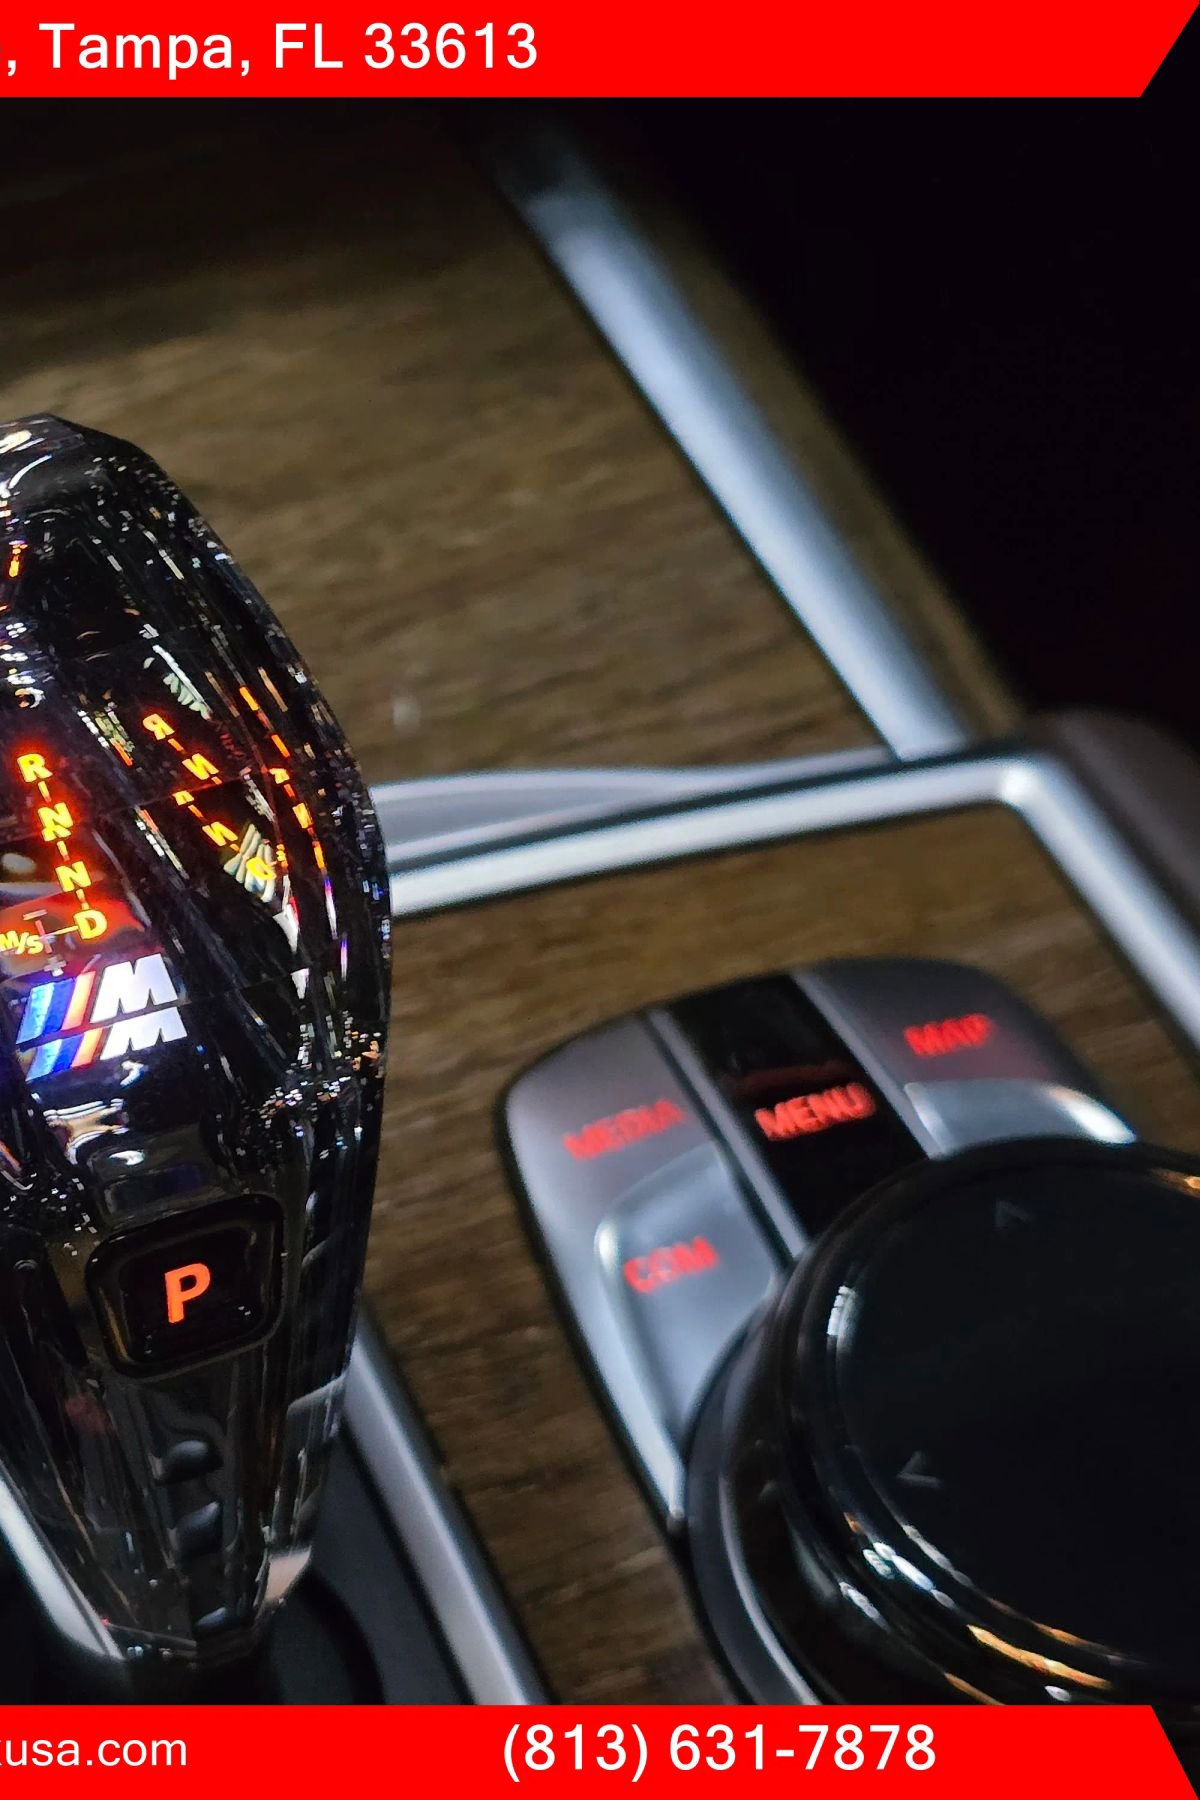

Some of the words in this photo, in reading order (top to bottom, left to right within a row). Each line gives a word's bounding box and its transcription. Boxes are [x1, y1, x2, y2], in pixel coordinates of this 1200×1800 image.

[17, 753, 54, 783] R
[55, 861, 92, 892] N
[73, 909, 108, 940] D
[904, 1012, 994, 1058] MAP
[563, 1099, 686, 1160] MEDIA
[754, 1081, 876, 1142] MENU
[624, 1236, 718, 1294] COM
[164, 1262, 212, 1324] P
